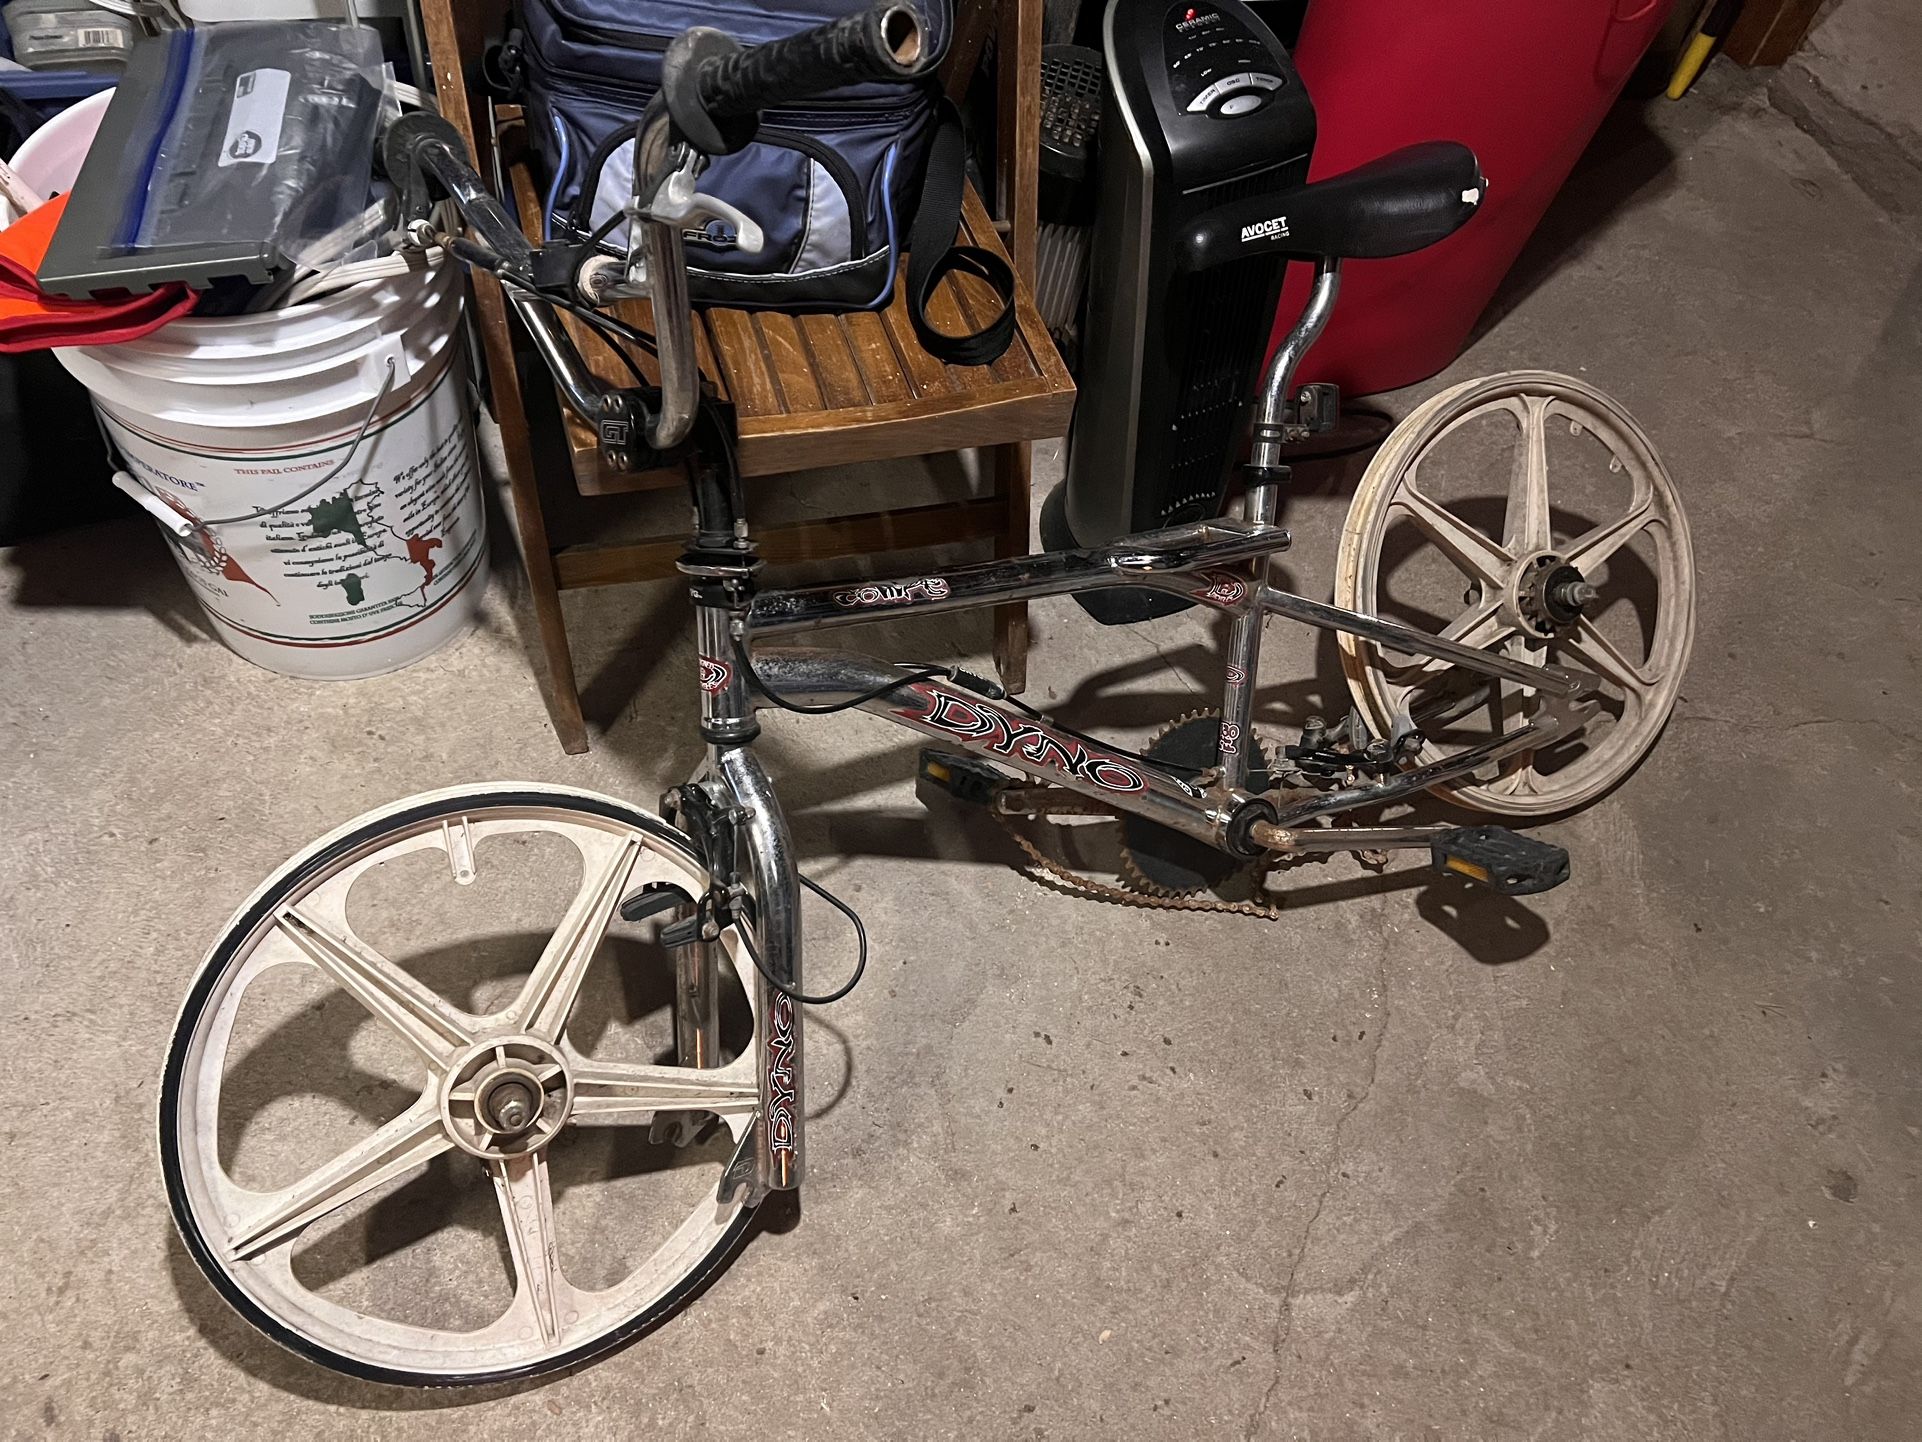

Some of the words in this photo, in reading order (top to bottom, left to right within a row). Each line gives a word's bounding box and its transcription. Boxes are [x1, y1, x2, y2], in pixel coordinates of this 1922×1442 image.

[1175, 12, 1219, 30] CERAMIC
[1241, 216, 1287, 240] AVOCET
[1270, 230, 1290, 241] RACING
[922, 689, 1144, 792] DYNO
[768, 991, 795, 1152] DYNO
